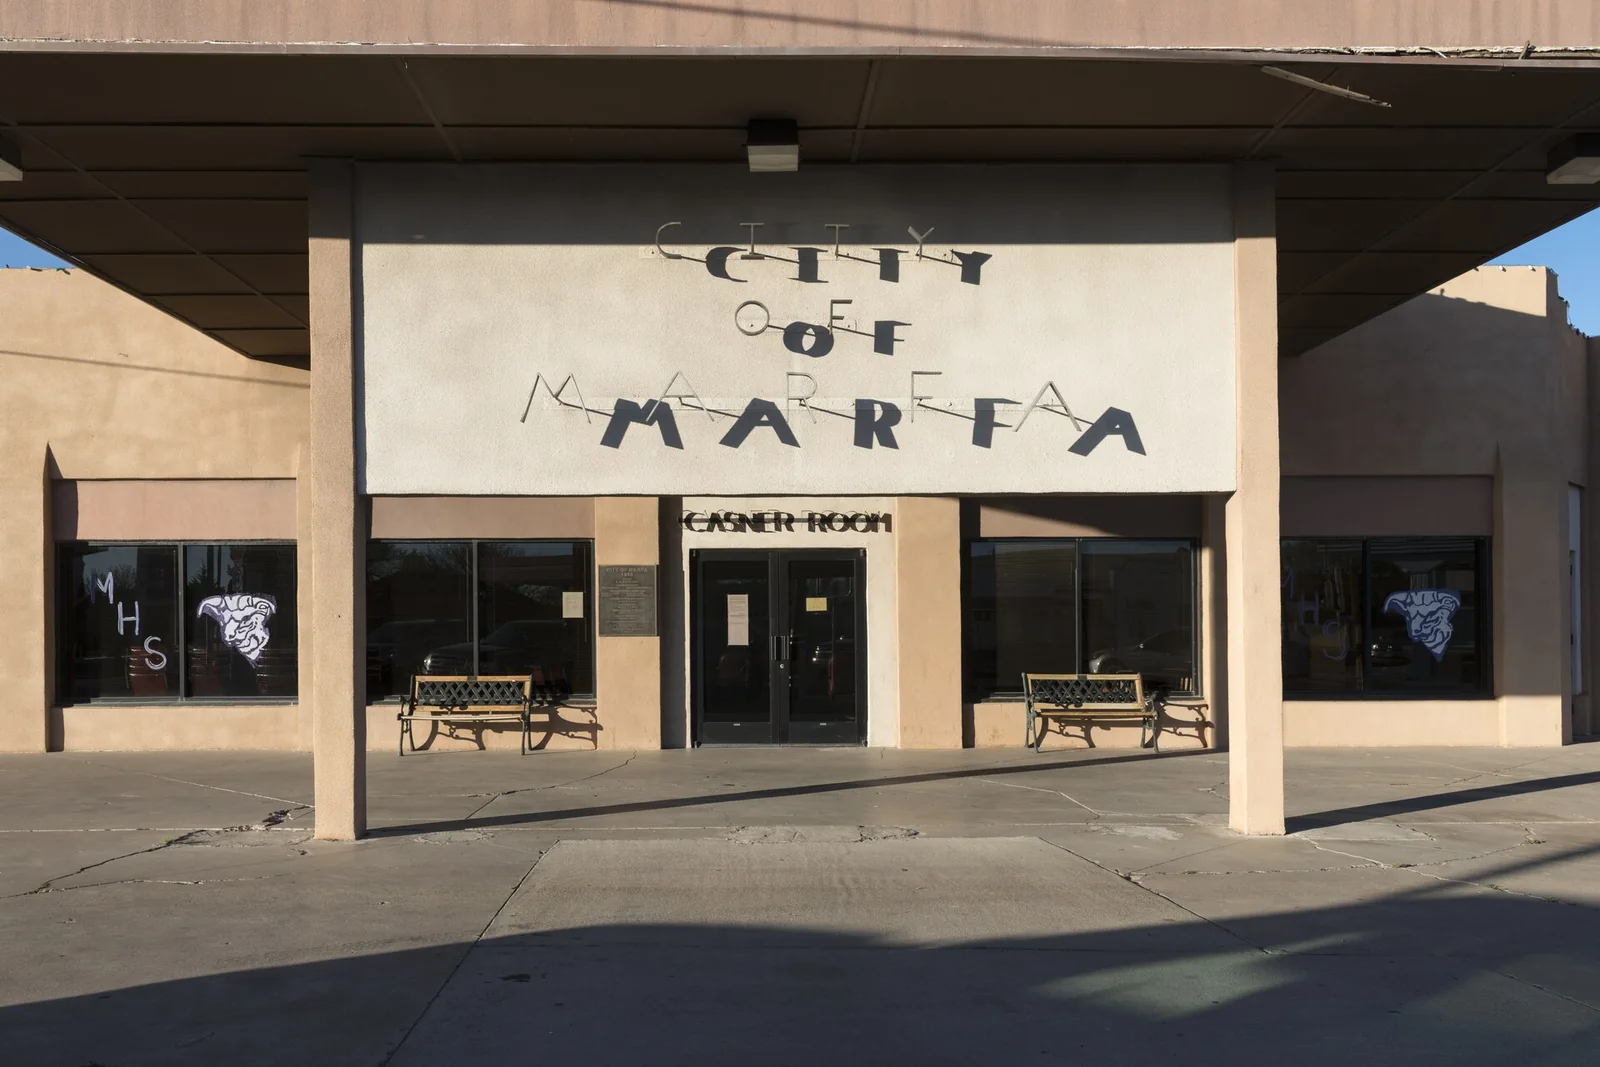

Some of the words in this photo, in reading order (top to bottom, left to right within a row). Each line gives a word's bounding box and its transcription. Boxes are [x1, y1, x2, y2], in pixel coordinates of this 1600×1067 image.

[655, 221, 935, 262] CITY
[734, 299, 854, 337] OF
[519, 370, 1083, 433] MARFA
[679, 508, 795, 534] CASNER
[801, 508, 893, 534] ROOM
